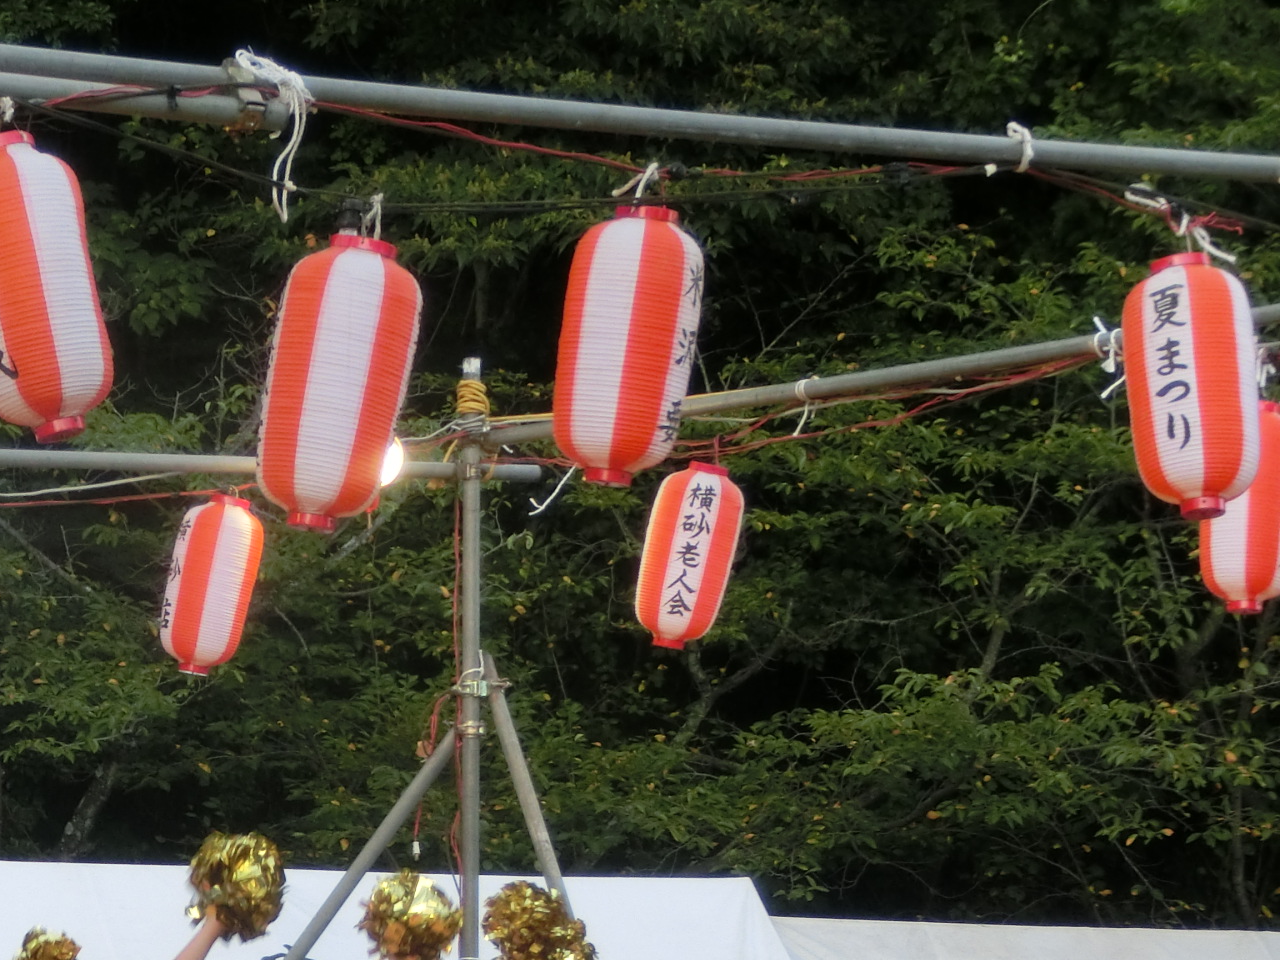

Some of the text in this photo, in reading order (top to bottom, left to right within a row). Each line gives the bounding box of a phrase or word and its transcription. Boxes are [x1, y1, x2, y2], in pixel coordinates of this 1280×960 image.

[1148, 284, 1193, 450] 夏まつり
[663, 482, 718, 617] 横砂老人会
